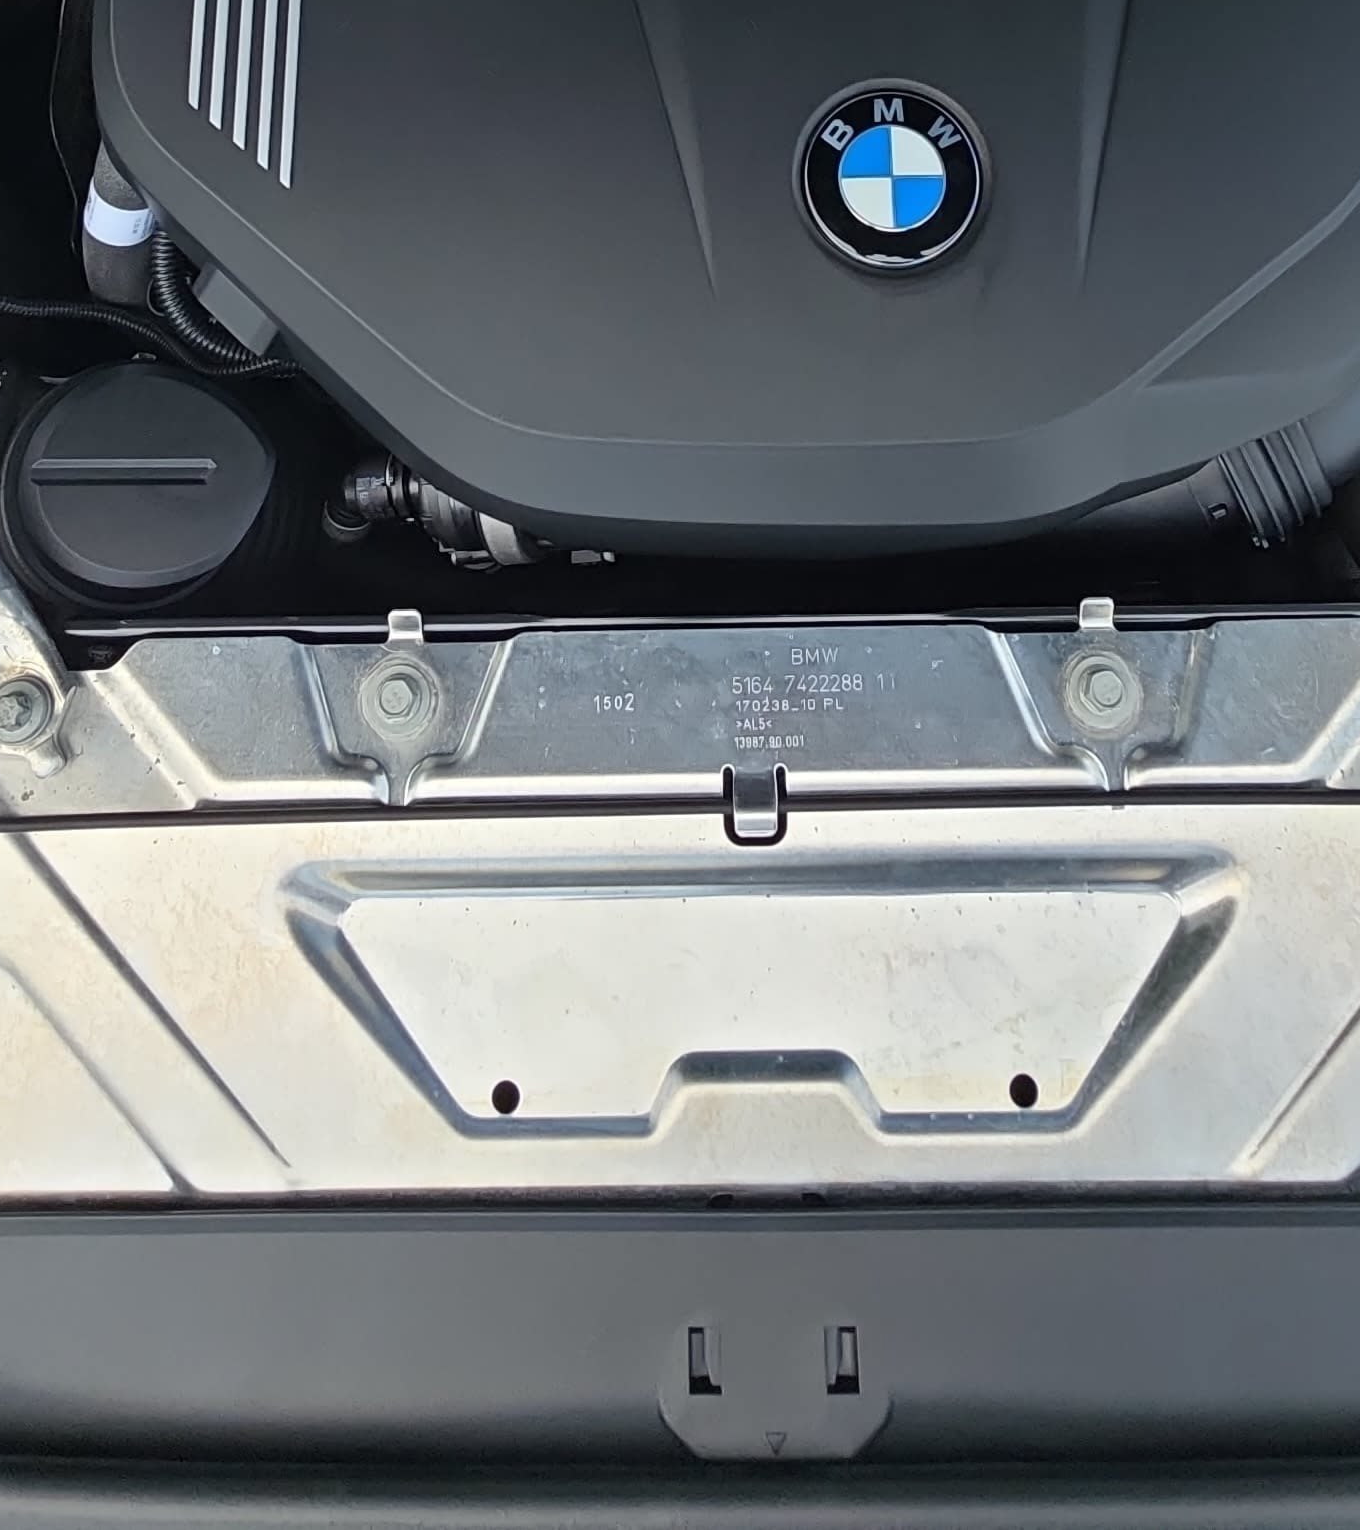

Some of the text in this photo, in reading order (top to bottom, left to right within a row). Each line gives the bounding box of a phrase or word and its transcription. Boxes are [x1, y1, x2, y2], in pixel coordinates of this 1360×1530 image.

[821, 97, 963, 151] BMW
[791, 647, 839, 665] BMW
[732, 676, 774, 695] 5164
[784, 673, 863, 694] 7422288
[593, 692, 635, 714] 1502
[735, 697, 844, 712] 170238_10 PL
